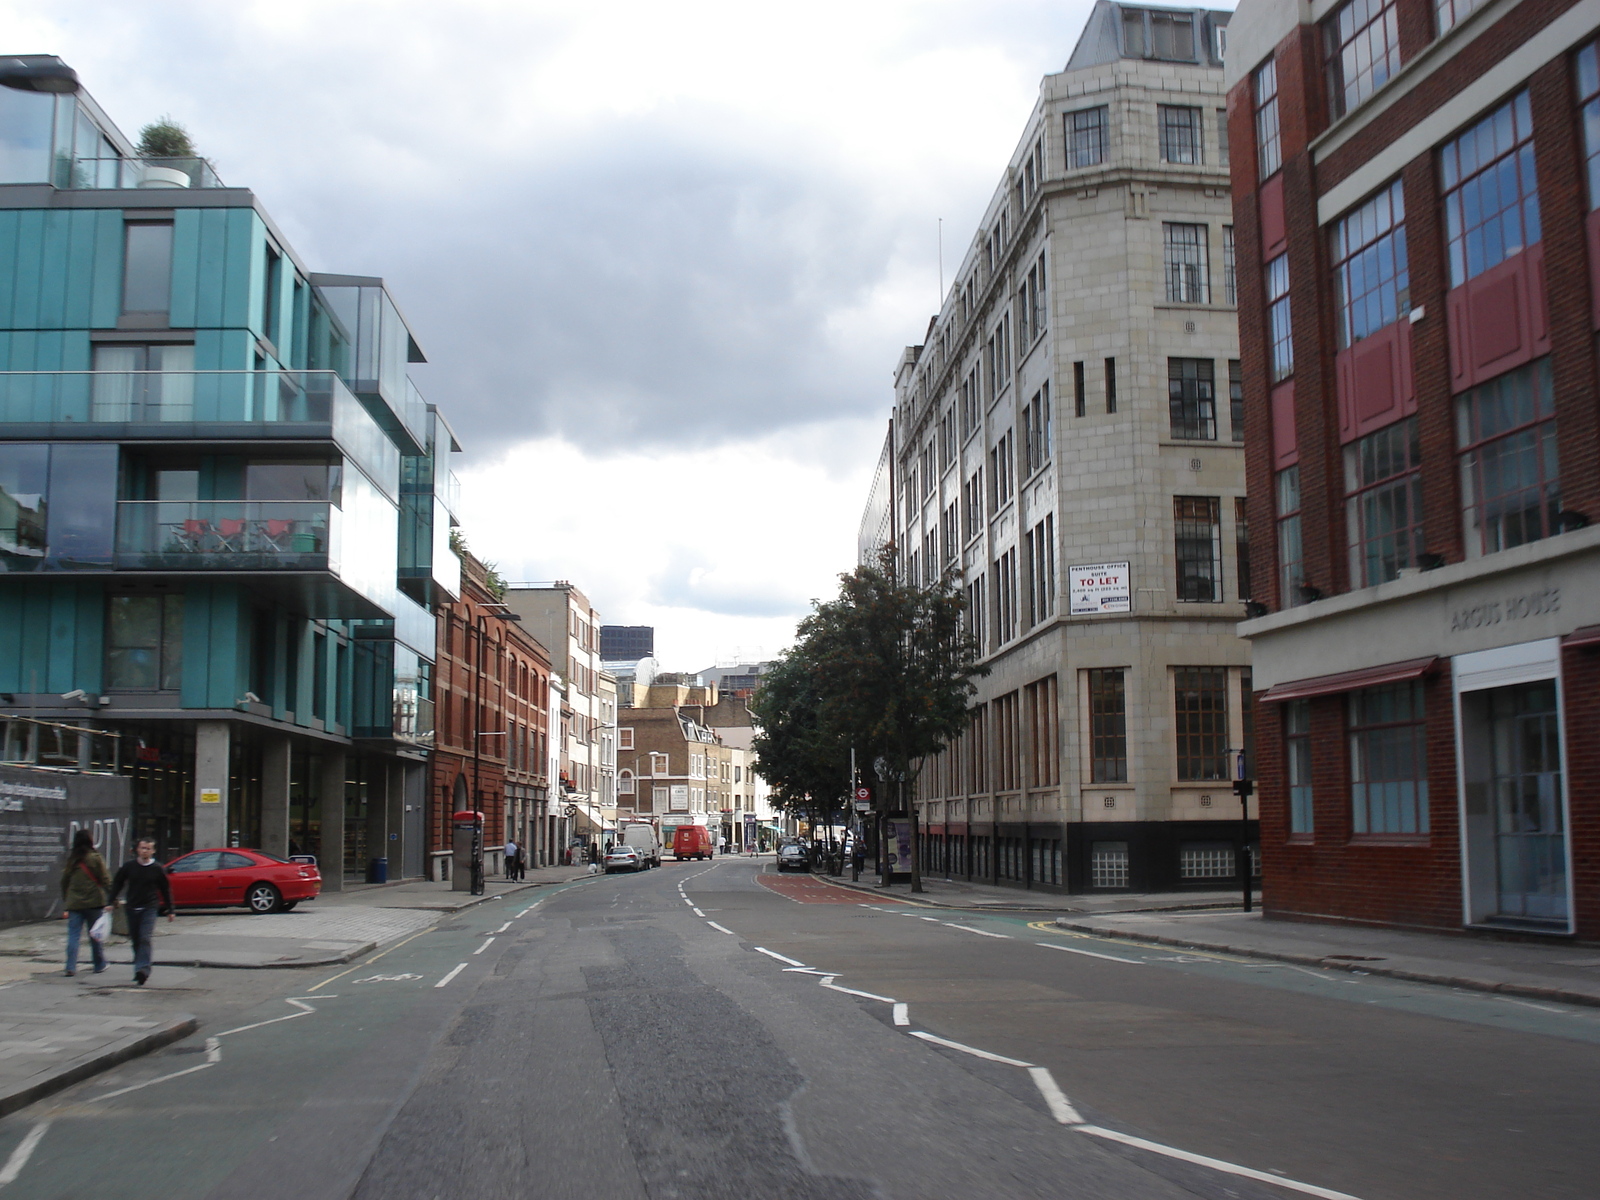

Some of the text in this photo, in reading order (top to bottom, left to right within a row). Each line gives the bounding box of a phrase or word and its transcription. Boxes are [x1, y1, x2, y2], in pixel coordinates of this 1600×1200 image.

[1079, 576, 1119, 586] TO LET
[1451, 588, 1561, 632] ARGUS HOUSE
